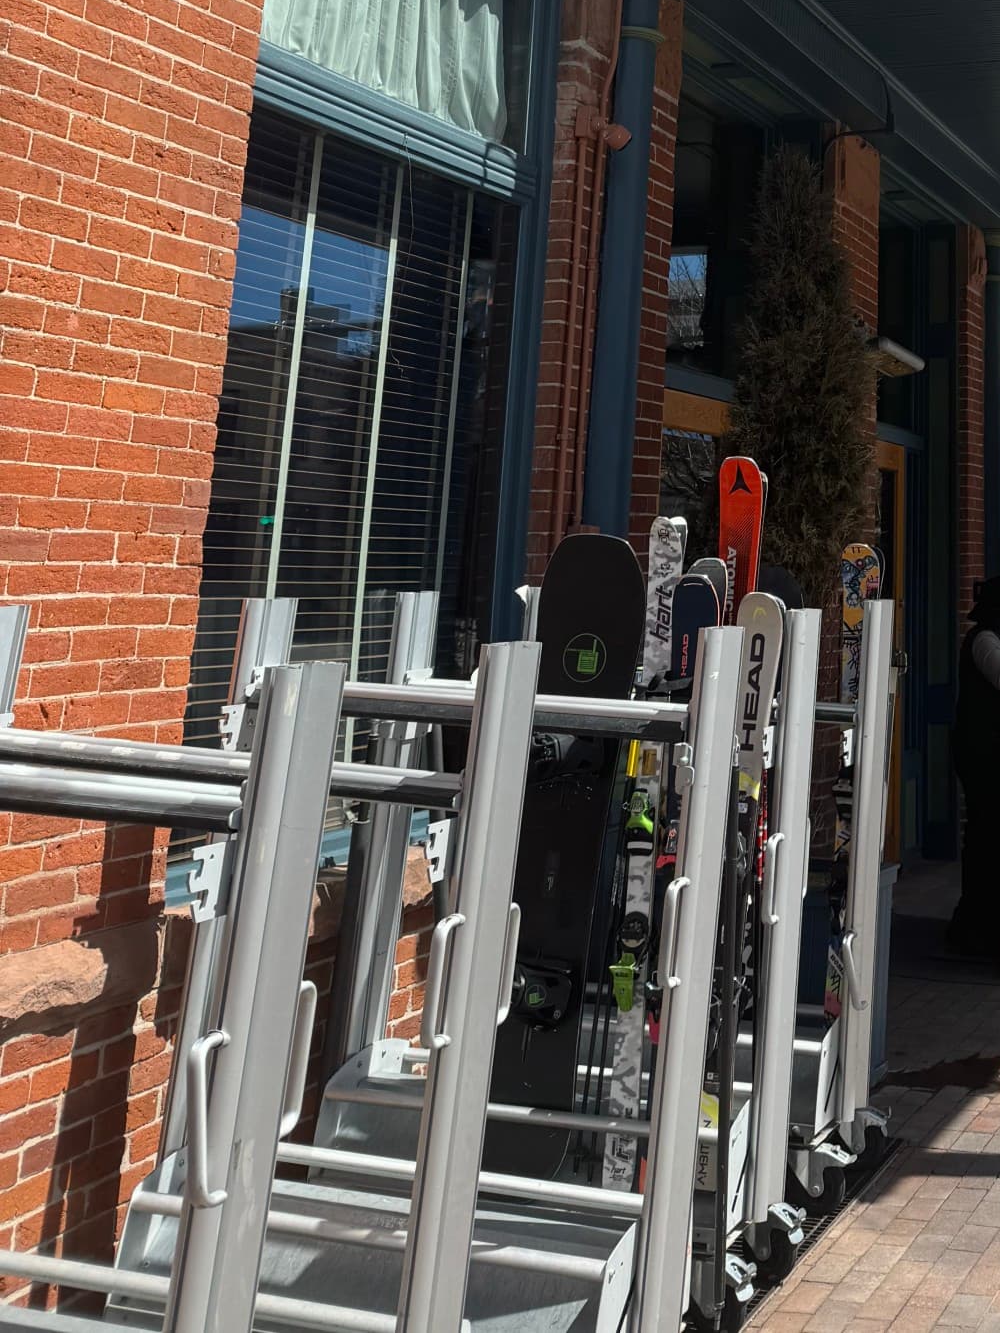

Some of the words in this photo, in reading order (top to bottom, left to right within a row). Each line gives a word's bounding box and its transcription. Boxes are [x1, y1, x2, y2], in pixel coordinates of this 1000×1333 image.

[726, 545, 737, 613] ATOMIC
[649, 584, 673, 643] hart
[680, 633, 690, 678] HEAD
[740, 632, 766, 752] HEAD
